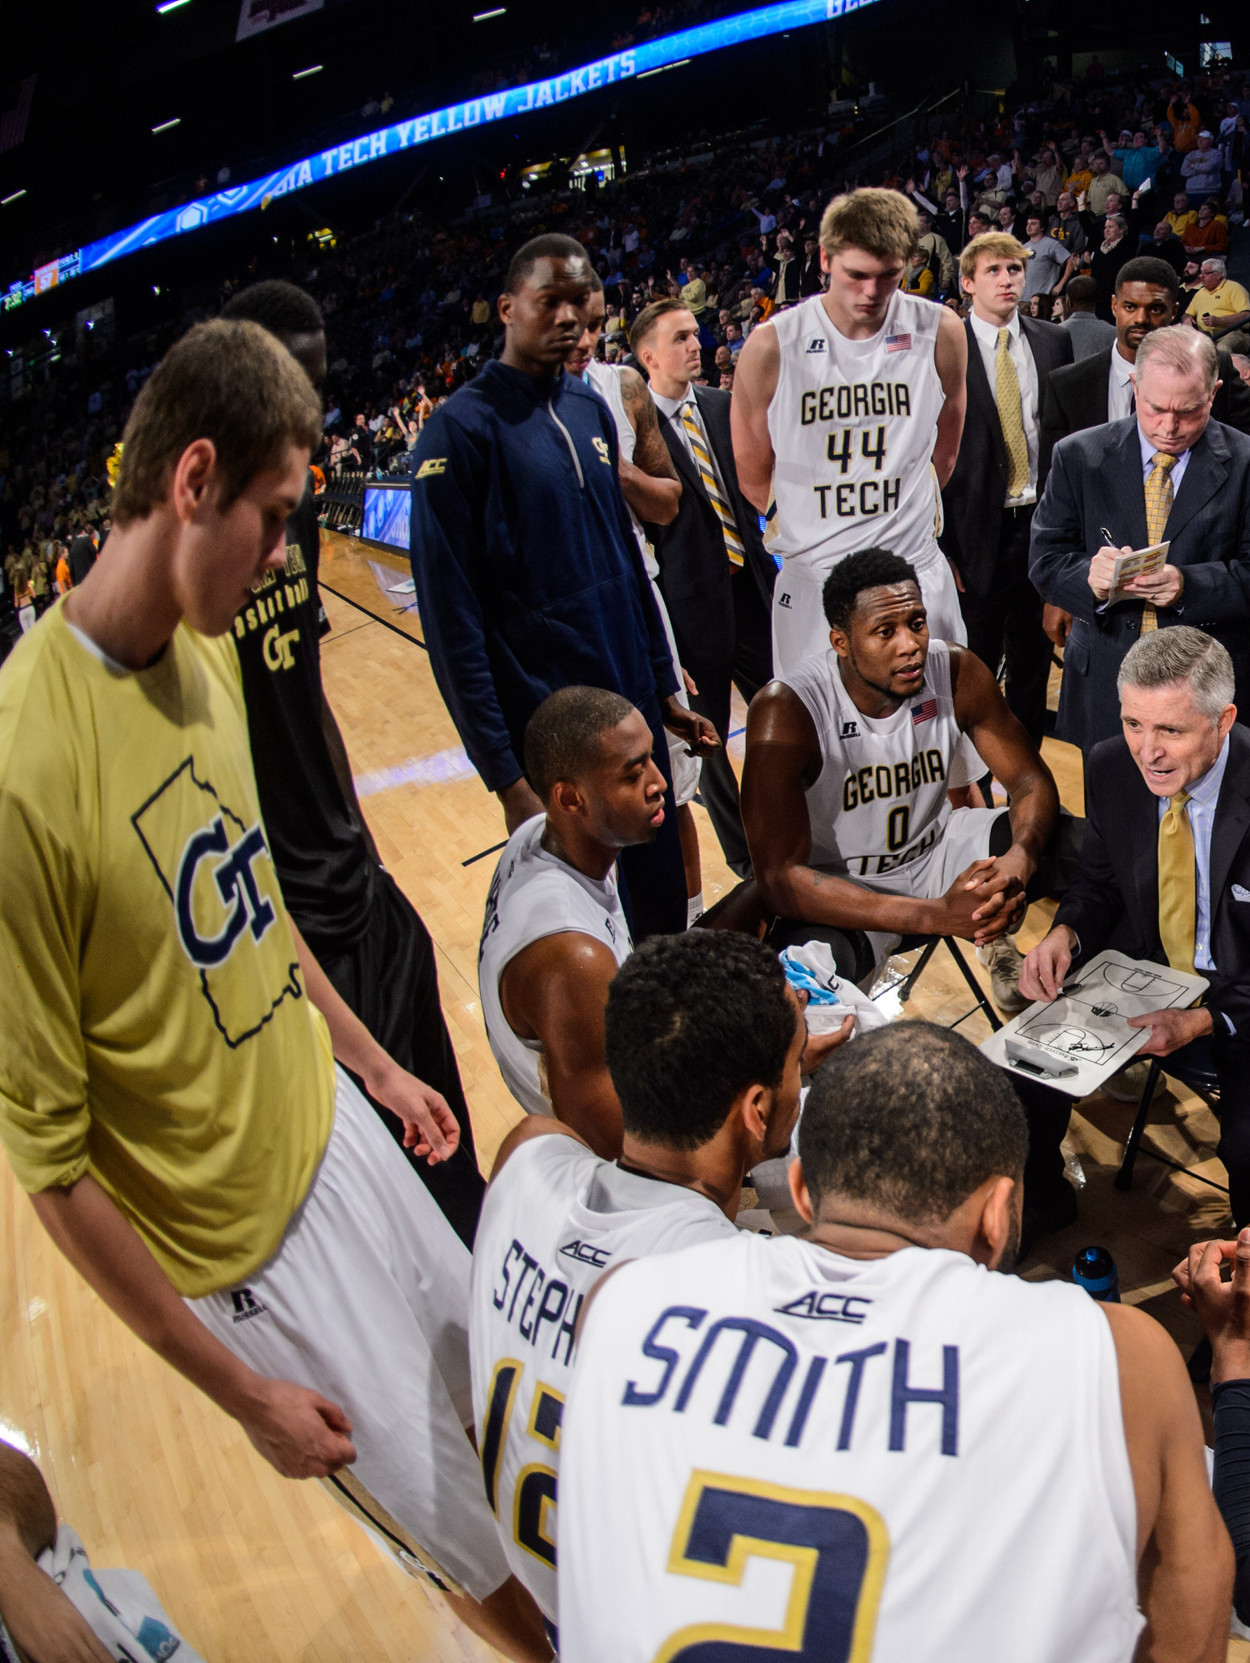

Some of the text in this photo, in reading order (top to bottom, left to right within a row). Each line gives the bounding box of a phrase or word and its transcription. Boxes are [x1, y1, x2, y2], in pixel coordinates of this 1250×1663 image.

[321, 128, 388, 176] TECH
[397, 90, 507, 148] YELLOW
[517, 50, 636, 113] JACKETS
[801, 382, 912, 426] GEORGIA
[415, 457, 448, 480] ACC
[826, 425, 888, 475] 44
[813, 477, 902, 519] TECH
[263, 623, 300, 672] GT
[843, 749, 946, 813] GEORGIA
[887, 804, 910, 853] 0
[175, 811, 278, 970] GT
[558, 1239, 612, 1269] ACC
[773, 1290, 874, 1324] ACC
[621, 1305, 960, 1457] SMITH
[648, 1467, 891, 1663] 2
